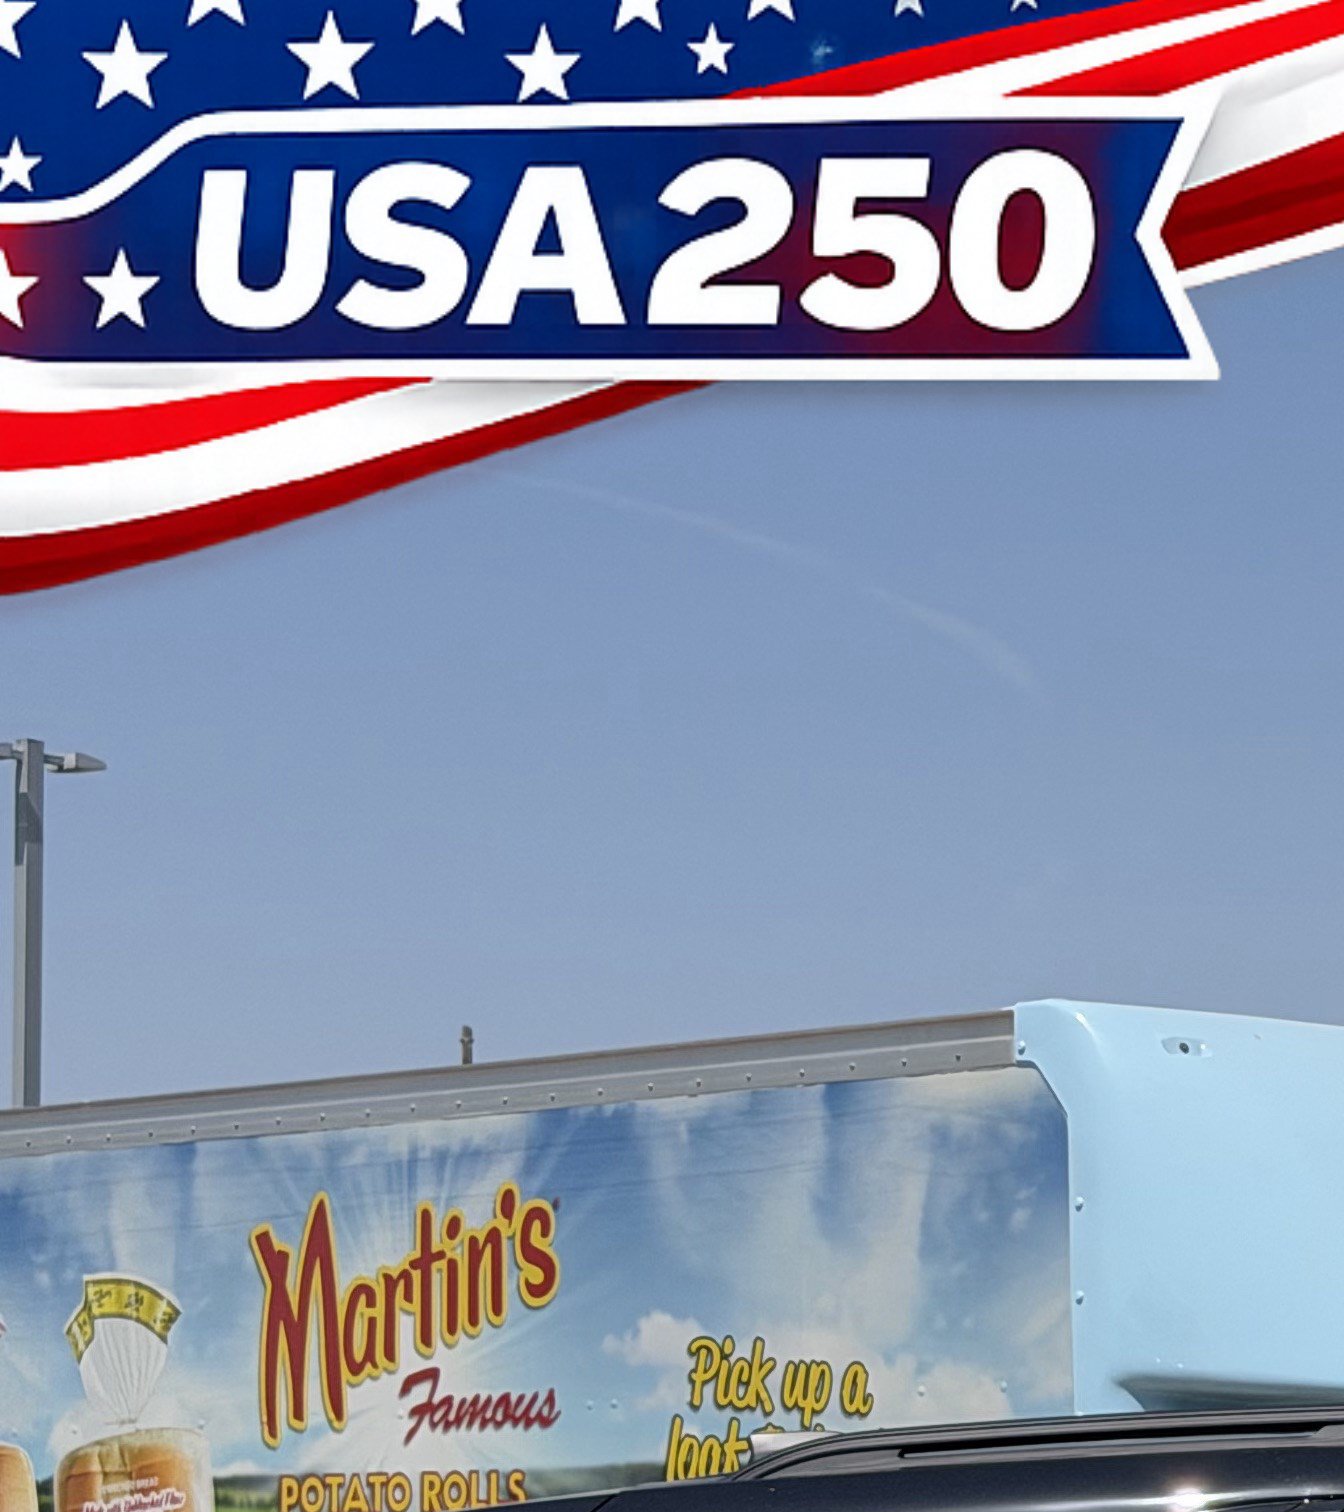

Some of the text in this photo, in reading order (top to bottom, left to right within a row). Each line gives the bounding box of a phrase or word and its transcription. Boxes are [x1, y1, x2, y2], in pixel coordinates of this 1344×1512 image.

[250, 1180, 560, 1450] Martin's
[399, 1366, 561, 1446] Famous
[688, 1335, 874, 1430] Pick up a
